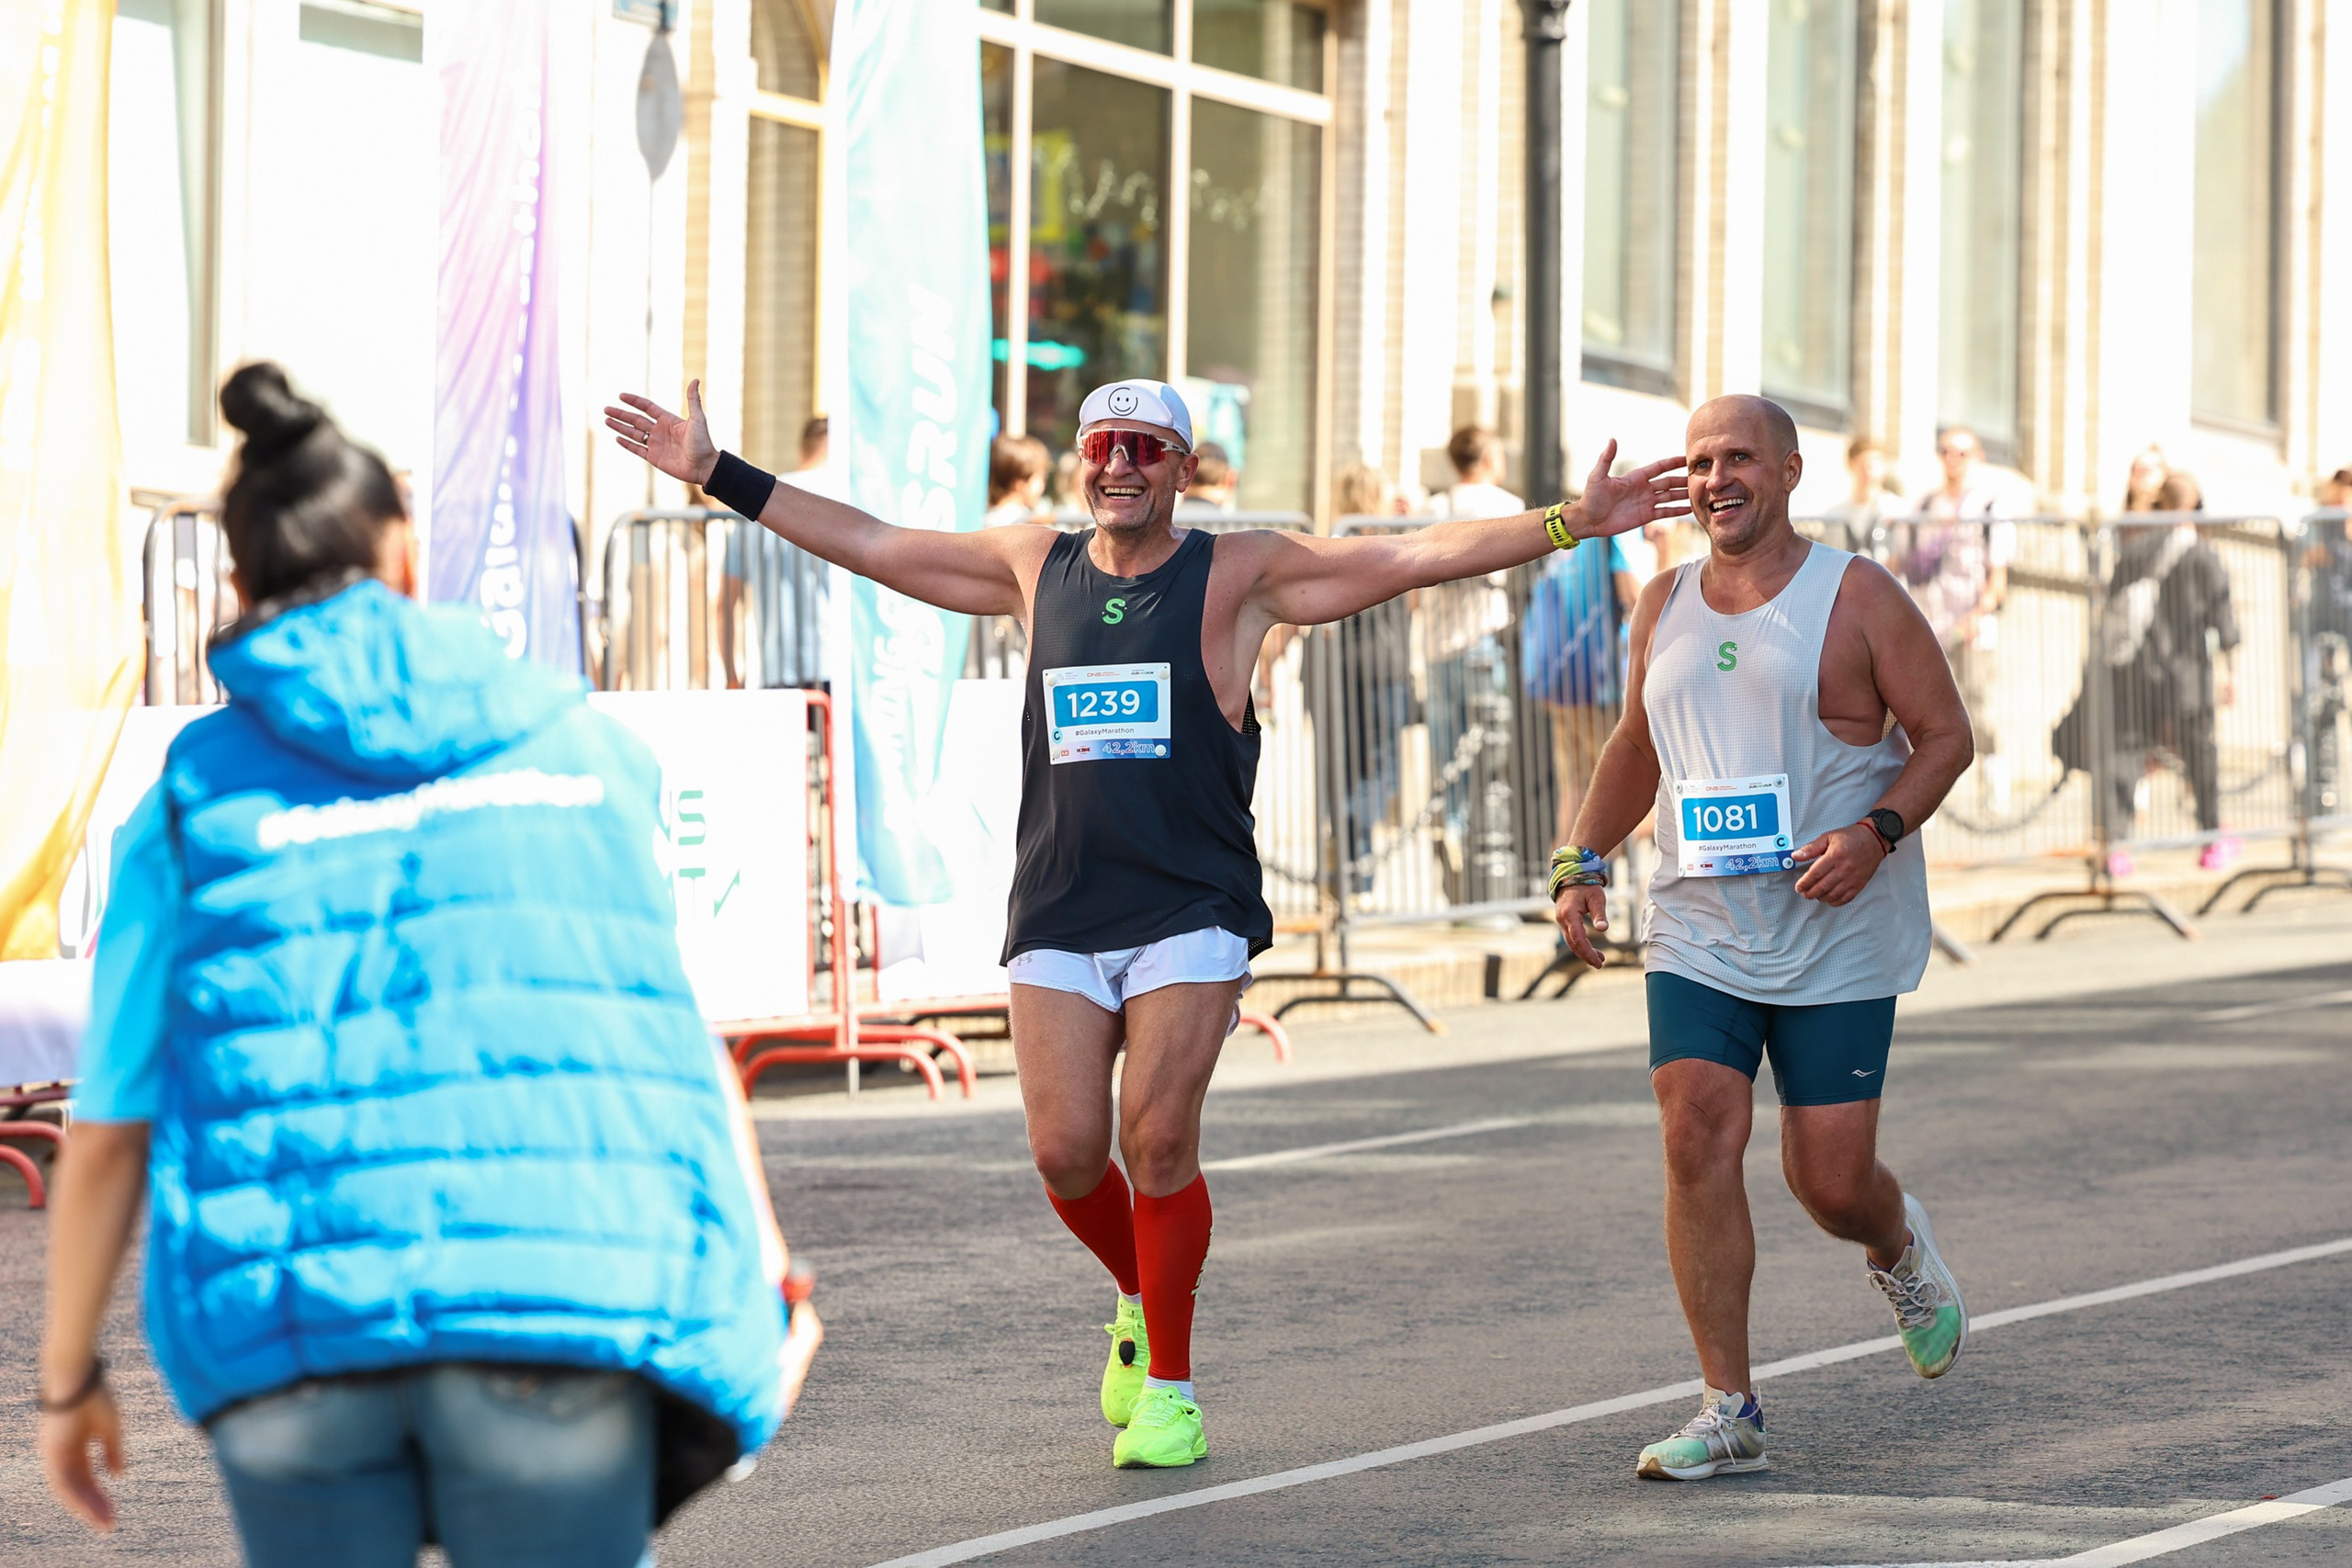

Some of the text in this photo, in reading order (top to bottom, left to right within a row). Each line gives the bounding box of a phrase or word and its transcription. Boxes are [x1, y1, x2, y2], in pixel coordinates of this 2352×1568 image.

[1717, 641, 1737, 671] S
[1067, 689, 1140, 718] 1239
[1053, 730, 1061, 740] C
[1075, 727, 1135, 738] #GalaxyMarathon
[1102, 740, 1156, 756] 42,2km
[1692, 803, 1758, 833] 1081
[1699, 842, 1757, 852] #GalaxyMarathon
[1776, 837, 1785, 847] C
[1724, 855, 1780, 873] 42,2km
